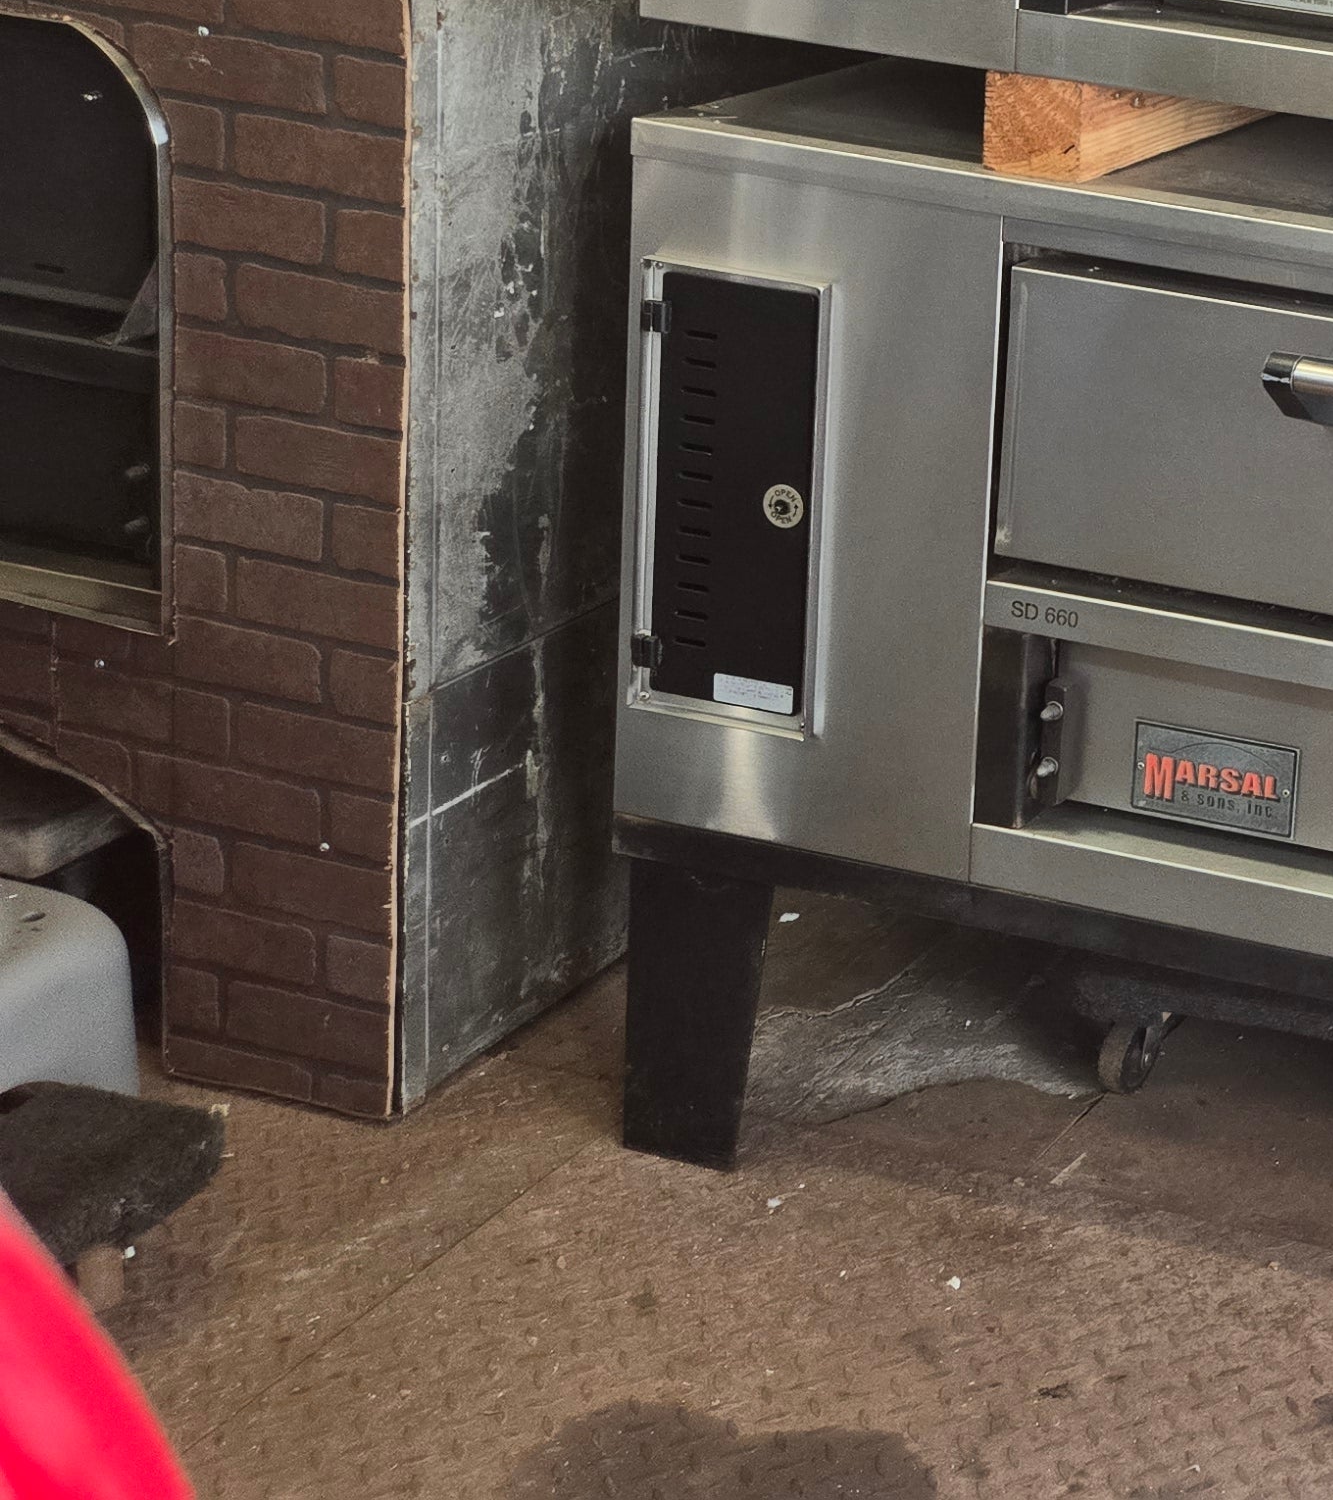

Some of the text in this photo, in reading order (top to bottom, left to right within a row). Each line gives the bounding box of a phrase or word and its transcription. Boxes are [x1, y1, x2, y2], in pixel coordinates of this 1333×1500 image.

[774, 489, 798, 502] OPEN
[1010, 600, 1079, 629] SD 660
[1143, 752, 1281, 803] MARSAL
